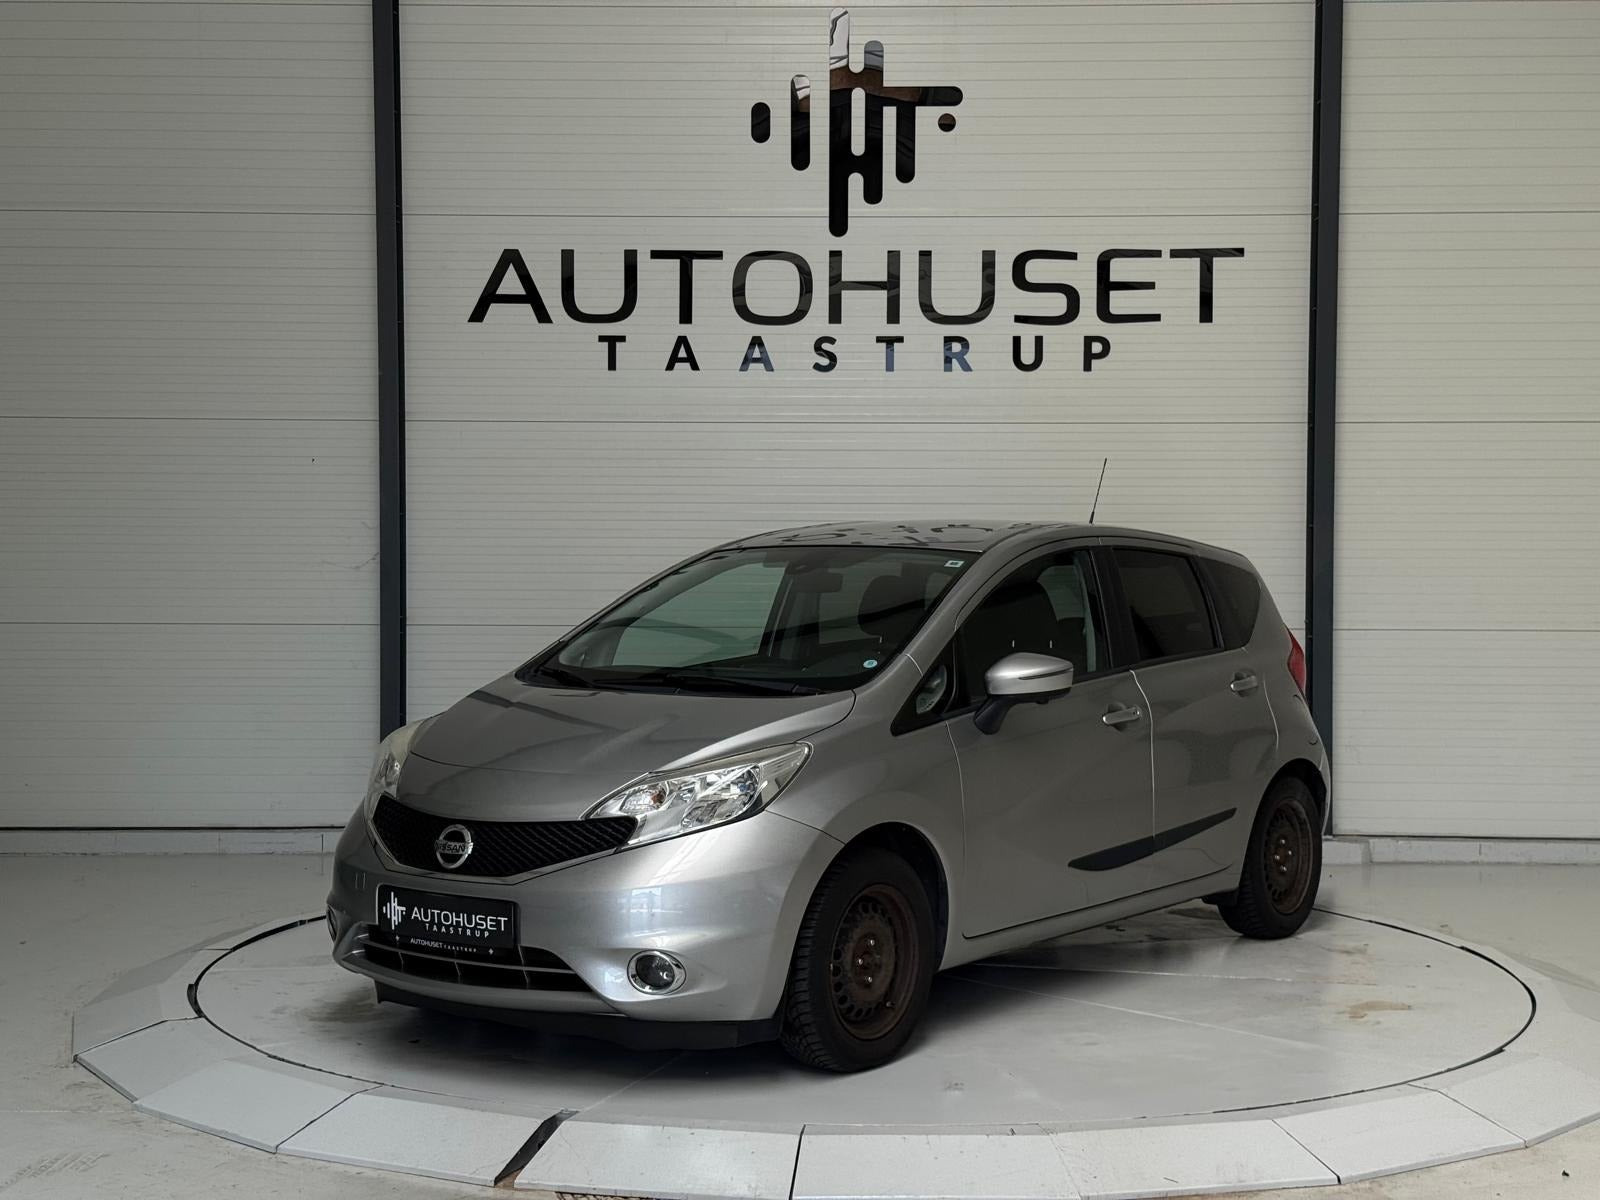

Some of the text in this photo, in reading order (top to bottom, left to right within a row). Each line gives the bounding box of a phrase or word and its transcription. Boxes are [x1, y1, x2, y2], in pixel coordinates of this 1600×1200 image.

[467, 247, 1245, 326] AUTOHUSET
[597, 334, 1112, 372] TAASTRUP
[411, 906, 508, 931] AUTOHUSET
[425, 923, 489, 938] TAASTRUP
